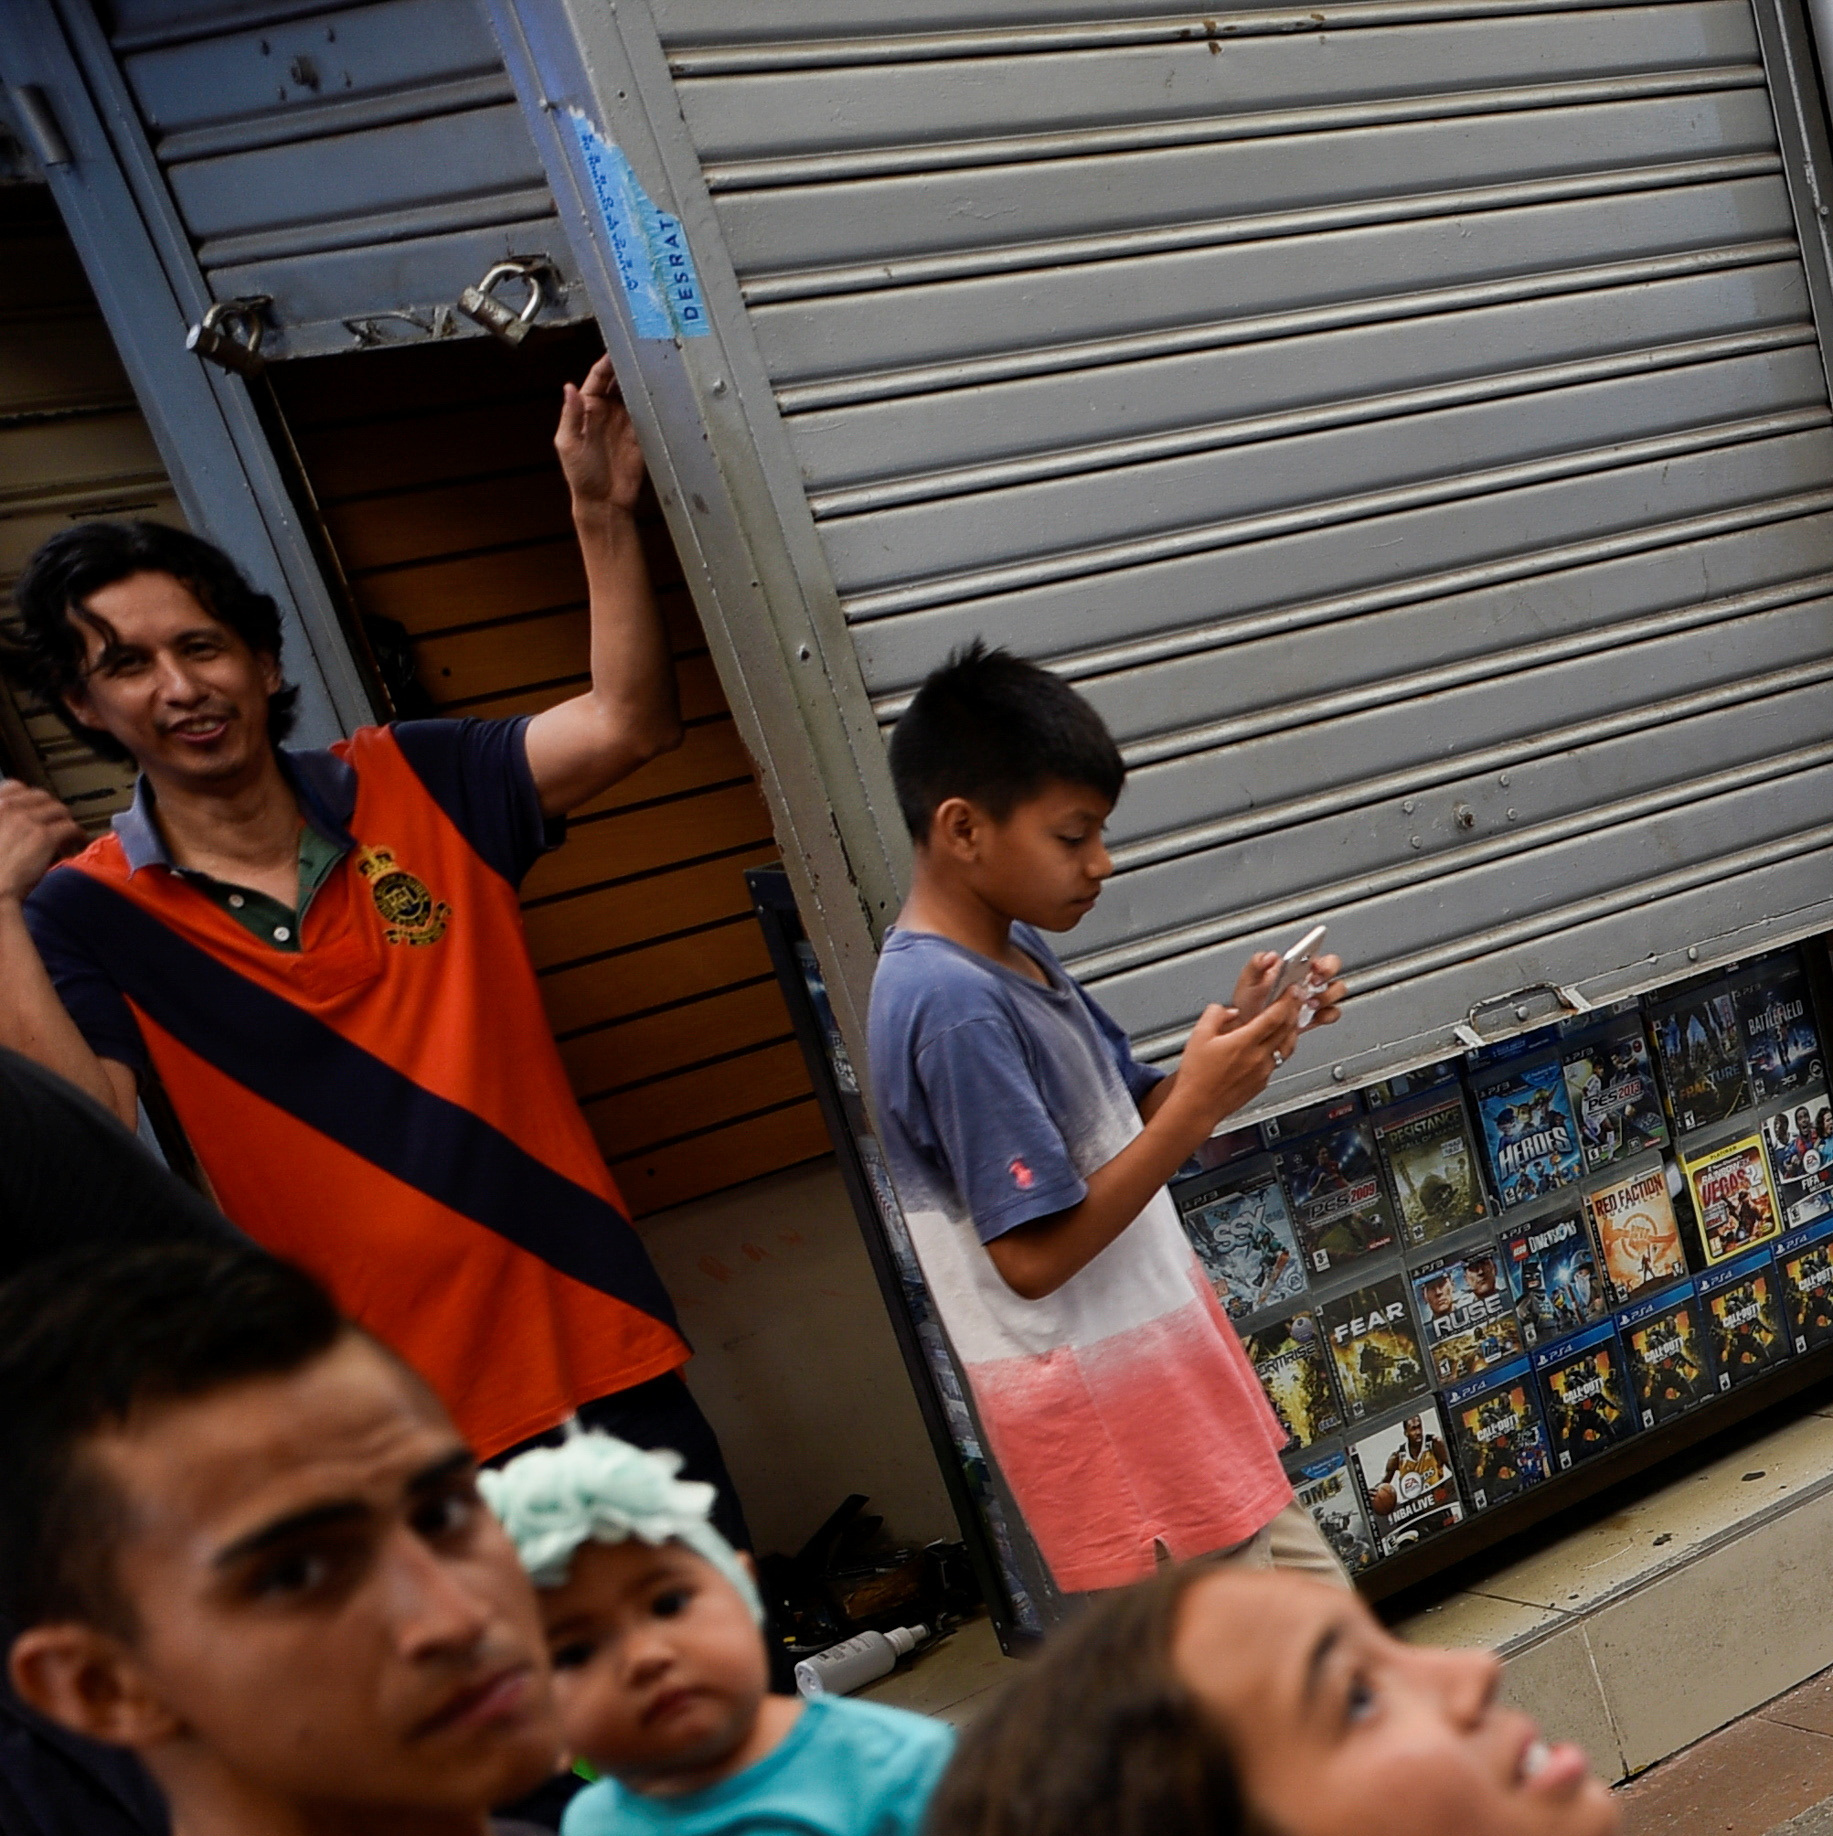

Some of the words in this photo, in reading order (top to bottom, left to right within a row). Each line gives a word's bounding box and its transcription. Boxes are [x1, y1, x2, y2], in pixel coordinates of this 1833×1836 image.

[656, 209, 699, 320] DESRAT
[1748, 1000, 1804, 1036] BATTLEFIELD
[1587, 1090, 1618, 1112] PES
[1618, 1083, 1642, 1100] 2013
[1389, 1106, 1461, 1143] RESISTANCE
[1499, 1126, 1573, 1179] HEROES
[1309, 1193, 1349, 1219] PES
[1349, 1182, 1376, 1203] 2009
[1595, 1197, 1617, 1217] RED
[1619, 1174, 1663, 1205] FACTION
[1701, 1170, 1747, 1207] VEGAS
[1748, 1163, 1763, 1186] 2
[1801, 1176, 1819, 1190] FIFA
[1213, 1204, 1275, 1256] SSX
[1528, 1220, 1577, 1253] DIMENSIONS
[1786, 1234, 1808, 1249] PS4
[1710, 1270, 1733, 1285] PS4
[1334, 1302, 1405, 1342] FEAR
[1433, 1293, 1503, 1337] RUSE
[1631, 1305, 1653, 1319] PS4
[1256, 1342, 1316, 1377] ORMRISE
[1550, 1344, 1573, 1360] PS4
[1462, 1380, 1486, 1397] PS4
[1393, 1508, 1412, 1524] NBA
[1412, 1495, 1436, 1512] LIVE
